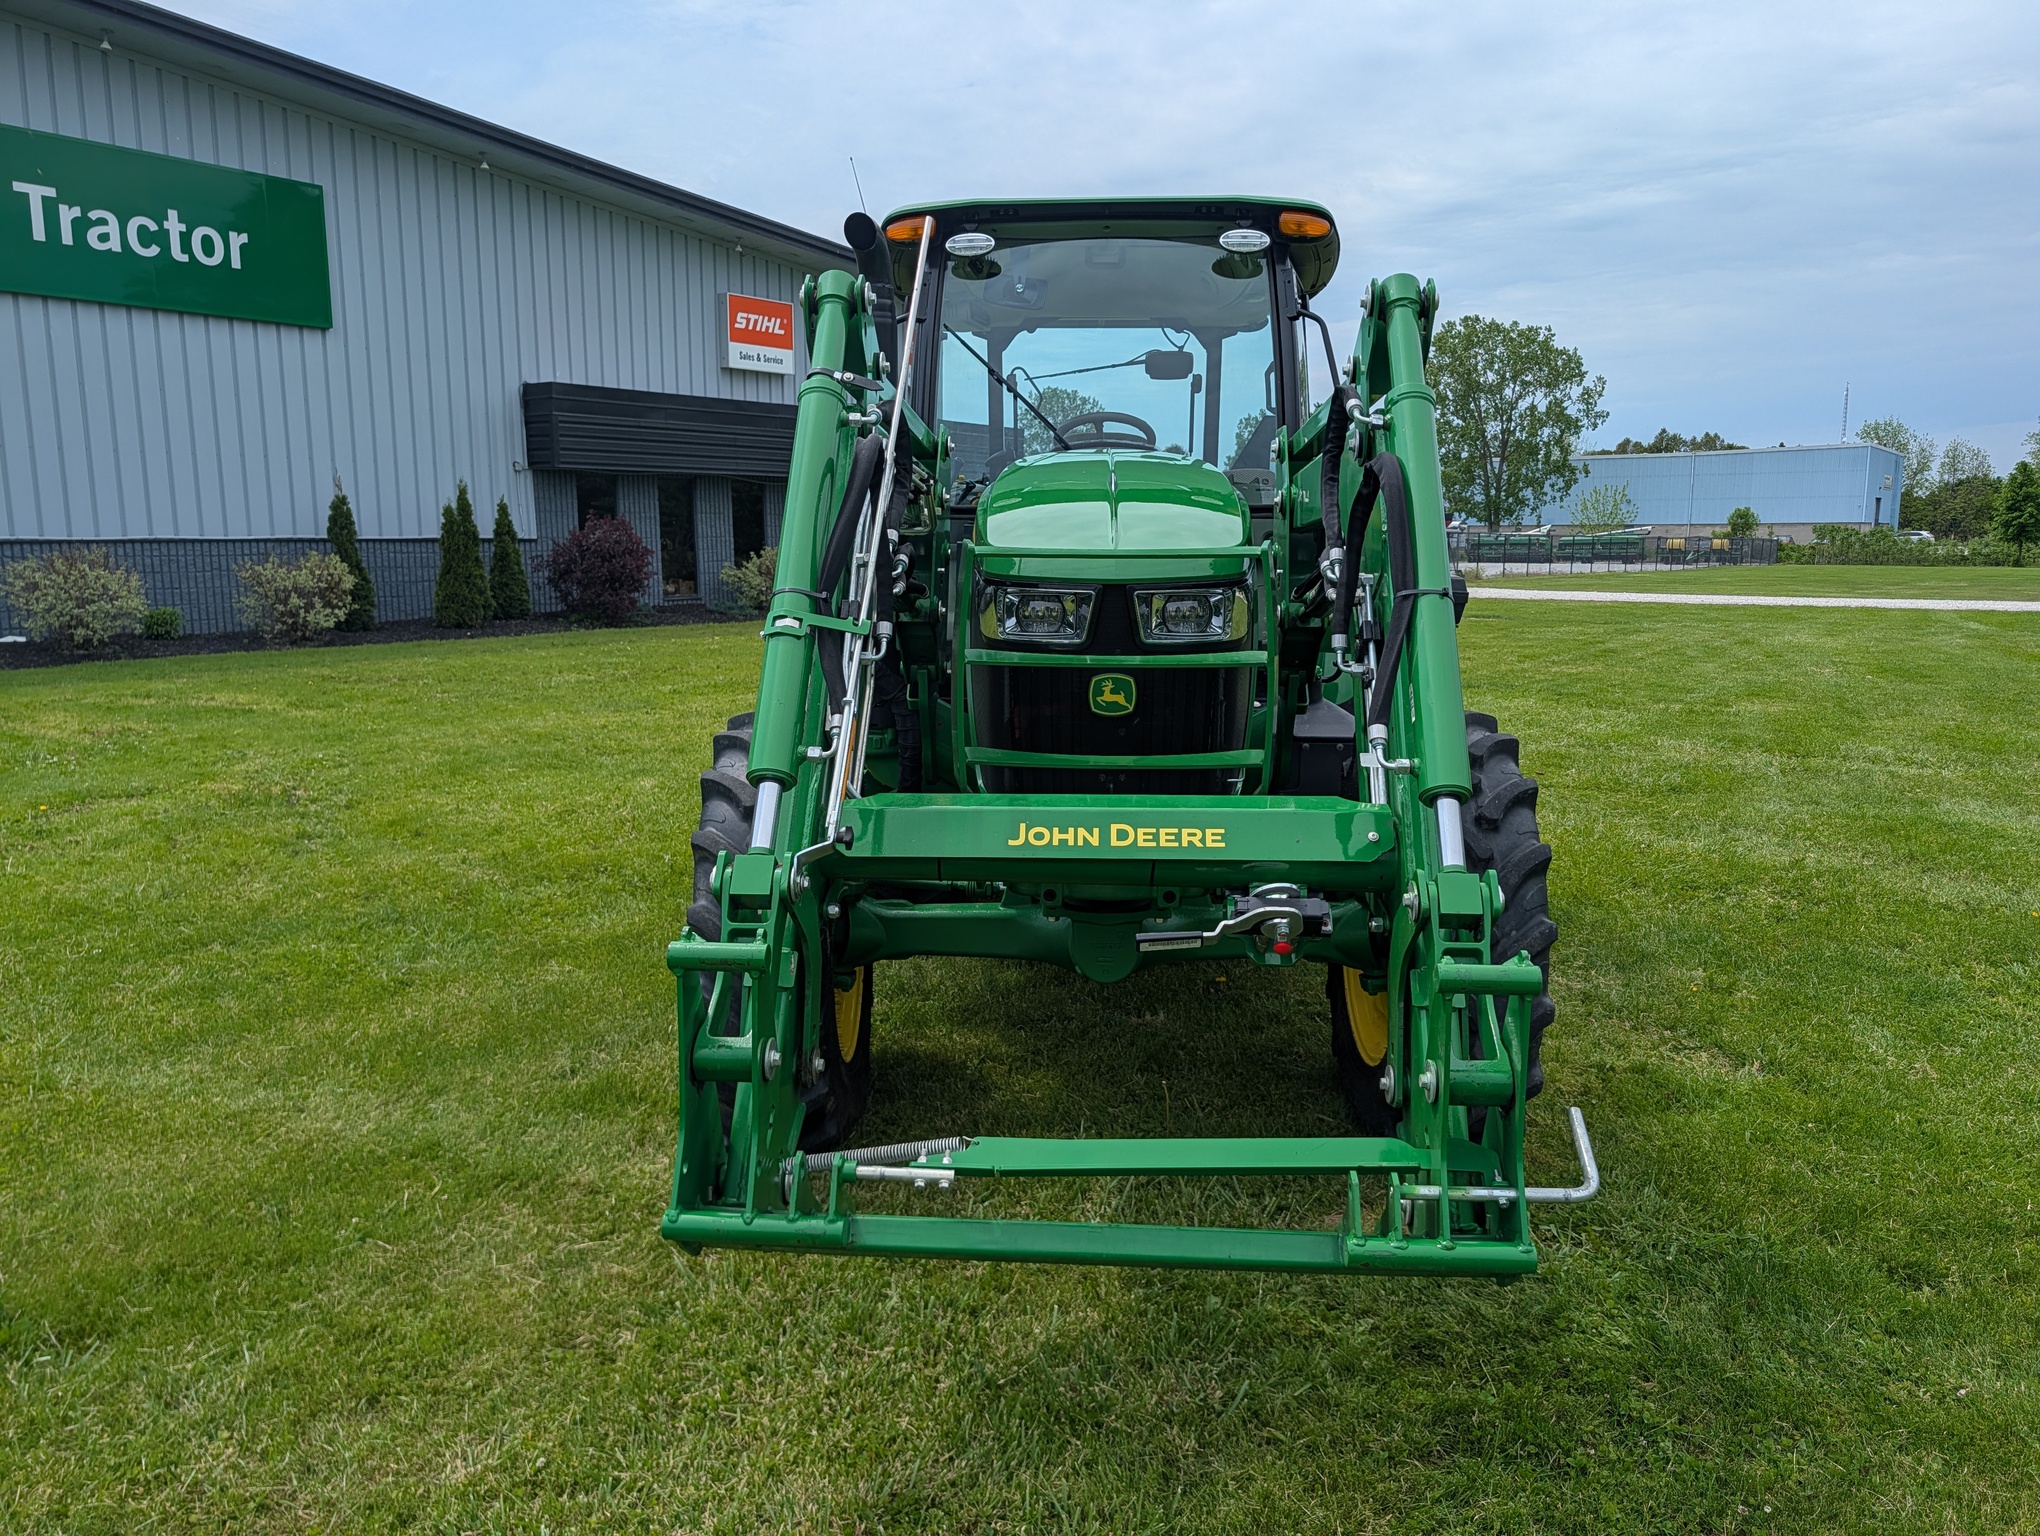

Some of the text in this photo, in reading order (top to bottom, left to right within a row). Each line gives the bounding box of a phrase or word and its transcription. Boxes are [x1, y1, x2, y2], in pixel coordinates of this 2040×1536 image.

[12, 180, 249, 270] Tractor
[734, 312, 785, 335] STIHL
[739, 351, 784, 365] Sales & Service
[1007, 822, 1226, 848] JOHN DEERE
